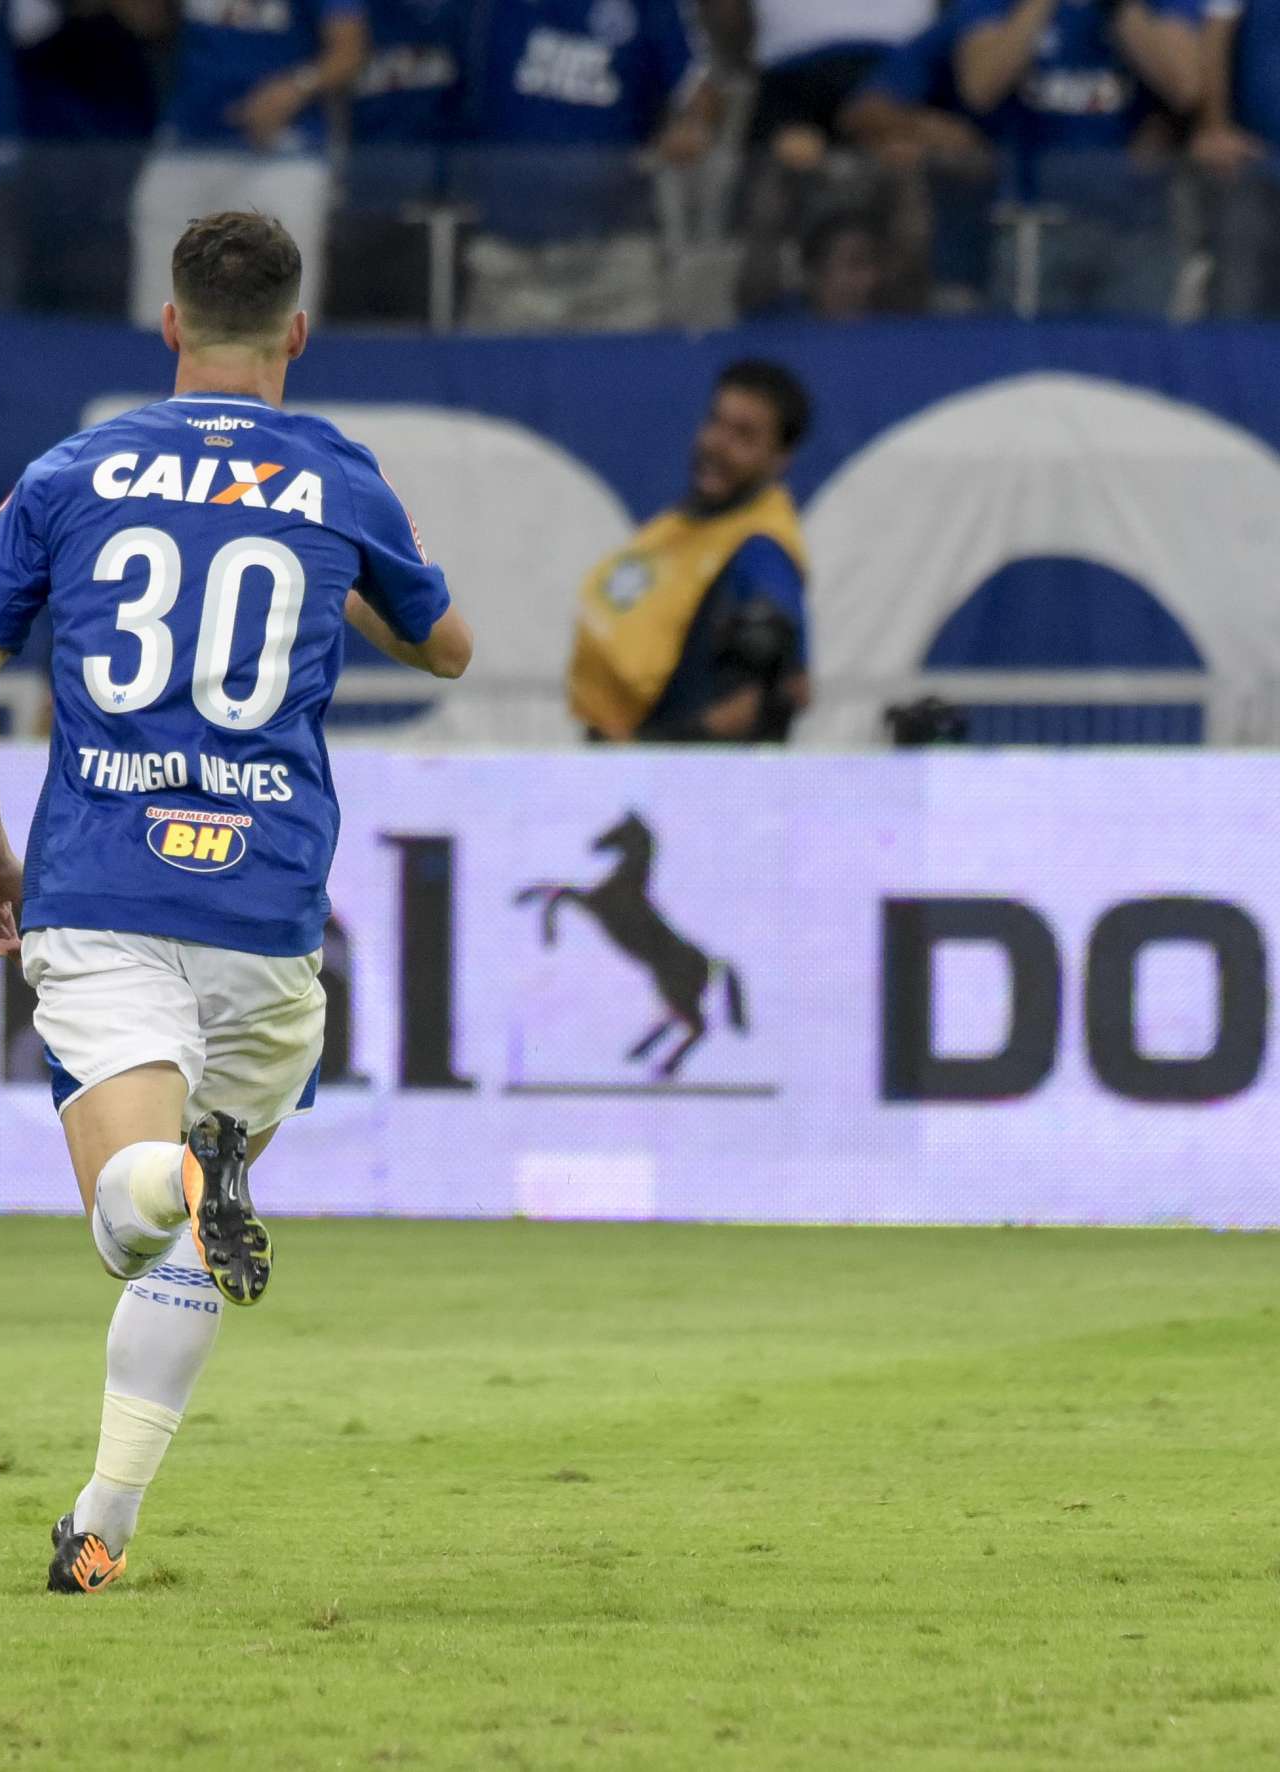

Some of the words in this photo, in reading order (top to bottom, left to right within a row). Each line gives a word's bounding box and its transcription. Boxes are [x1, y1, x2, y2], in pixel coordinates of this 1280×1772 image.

[186, 415, 256, 431] umbro
[92, 453, 323, 524] CAIXA
[83, 527, 306, 730] 30
[78, 747, 188, 793] THIAGO
[200, 753, 293, 802] NEVES
[146, 806, 253, 826] SUPERMERCADOS
[161, 822, 233, 863] BH
[880, 896, 1267, 1104] DO
